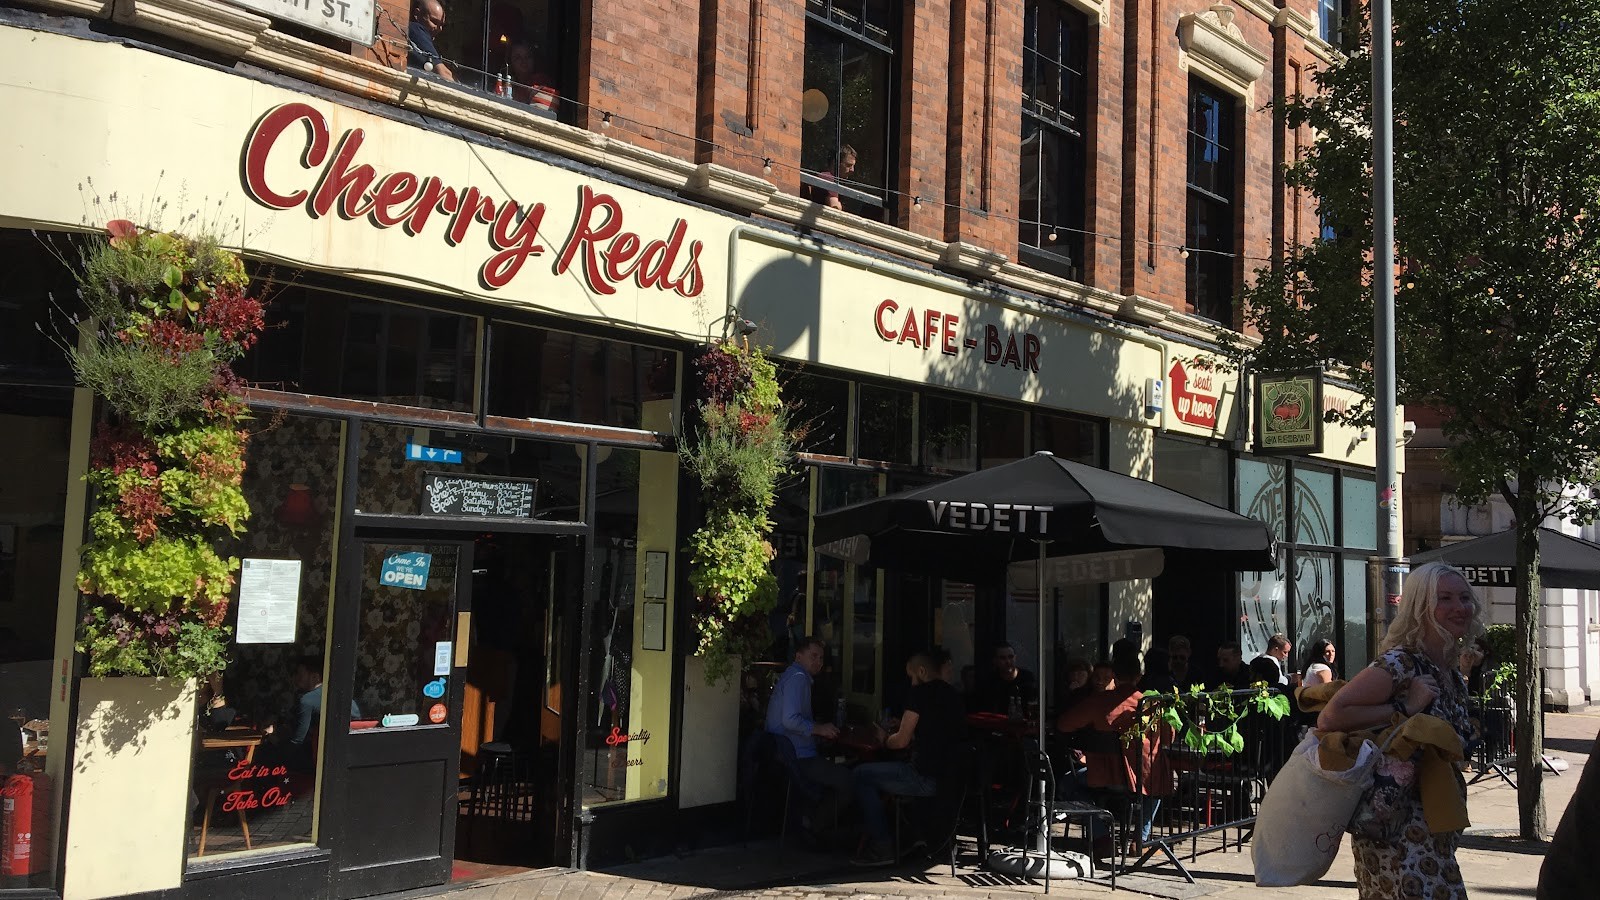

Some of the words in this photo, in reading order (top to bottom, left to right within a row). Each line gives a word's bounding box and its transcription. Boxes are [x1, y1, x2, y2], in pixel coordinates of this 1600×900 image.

[239, 102, 546, 291] Cherry
[551, 184, 704, 298] Reds
[1193, 372, 1213, 392] seats
[1178, 396, 1190, 421] up
[1191, 394, 1213, 419] here
[426, 477, 443, 496] We
[430, 490, 449, 503] are
[463, 496, 494, 509] Saturday
[926, 500, 1054, 534] VEDETT
[388, 552, 411, 565] Come
[413, 556, 425, 567] In
[384, 570, 424, 586] OPEN
[1456, 566, 1512, 583] DETT
[605, 726, 651, 747] Speciality
[228, 759, 257, 780] Eat
[257, 765, 269, 777] in
[272, 765, 287, 775] or
[222, 790, 258, 812] Take
[261, 786, 292, 808] Out
